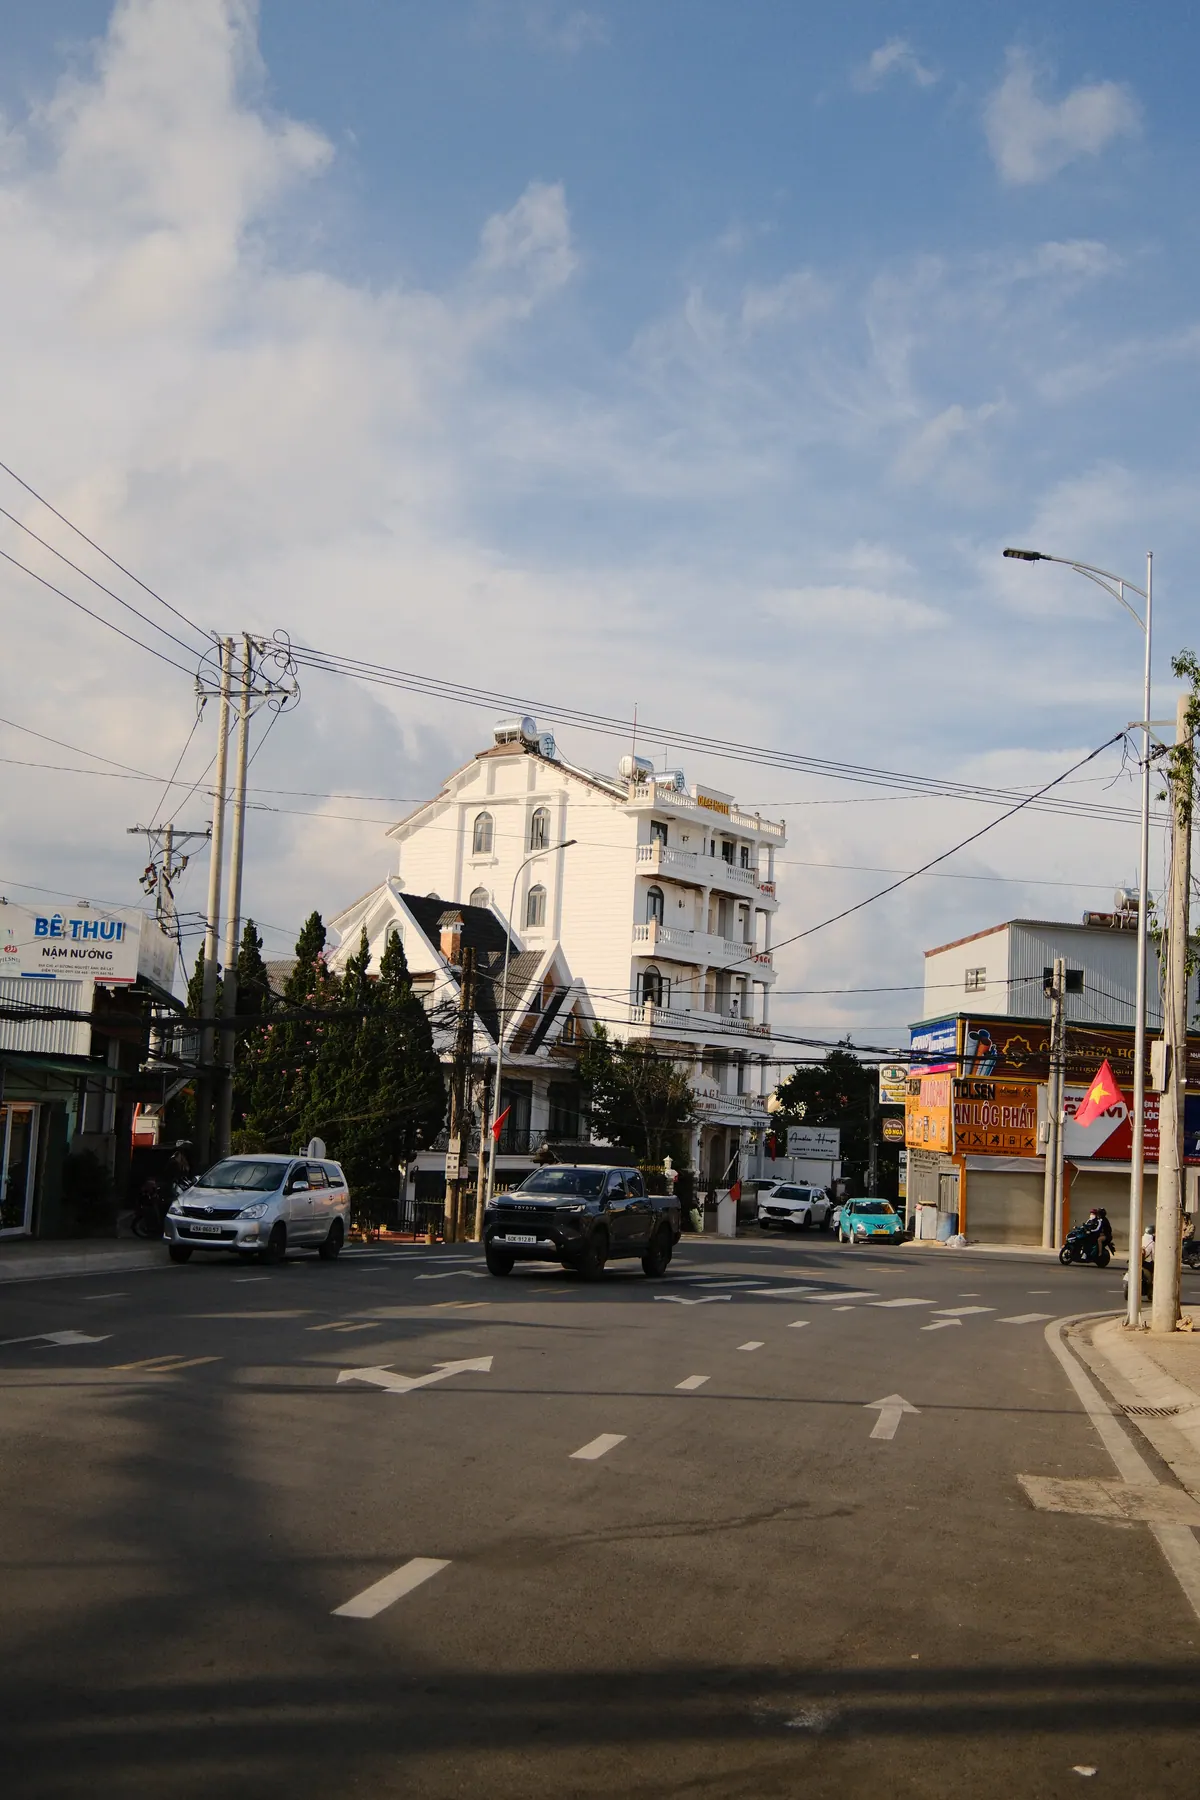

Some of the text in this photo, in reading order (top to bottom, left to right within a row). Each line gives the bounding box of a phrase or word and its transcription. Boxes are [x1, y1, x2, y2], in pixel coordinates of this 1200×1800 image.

[34, 914, 123, 940] BÊ THUI
[42, 946, 113, 959] NẬM NƯỚNG
[954, 1083, 995, 1099] TOLSEN
[954, 1100, 1035, 1130] AN LỘC PHÁT
